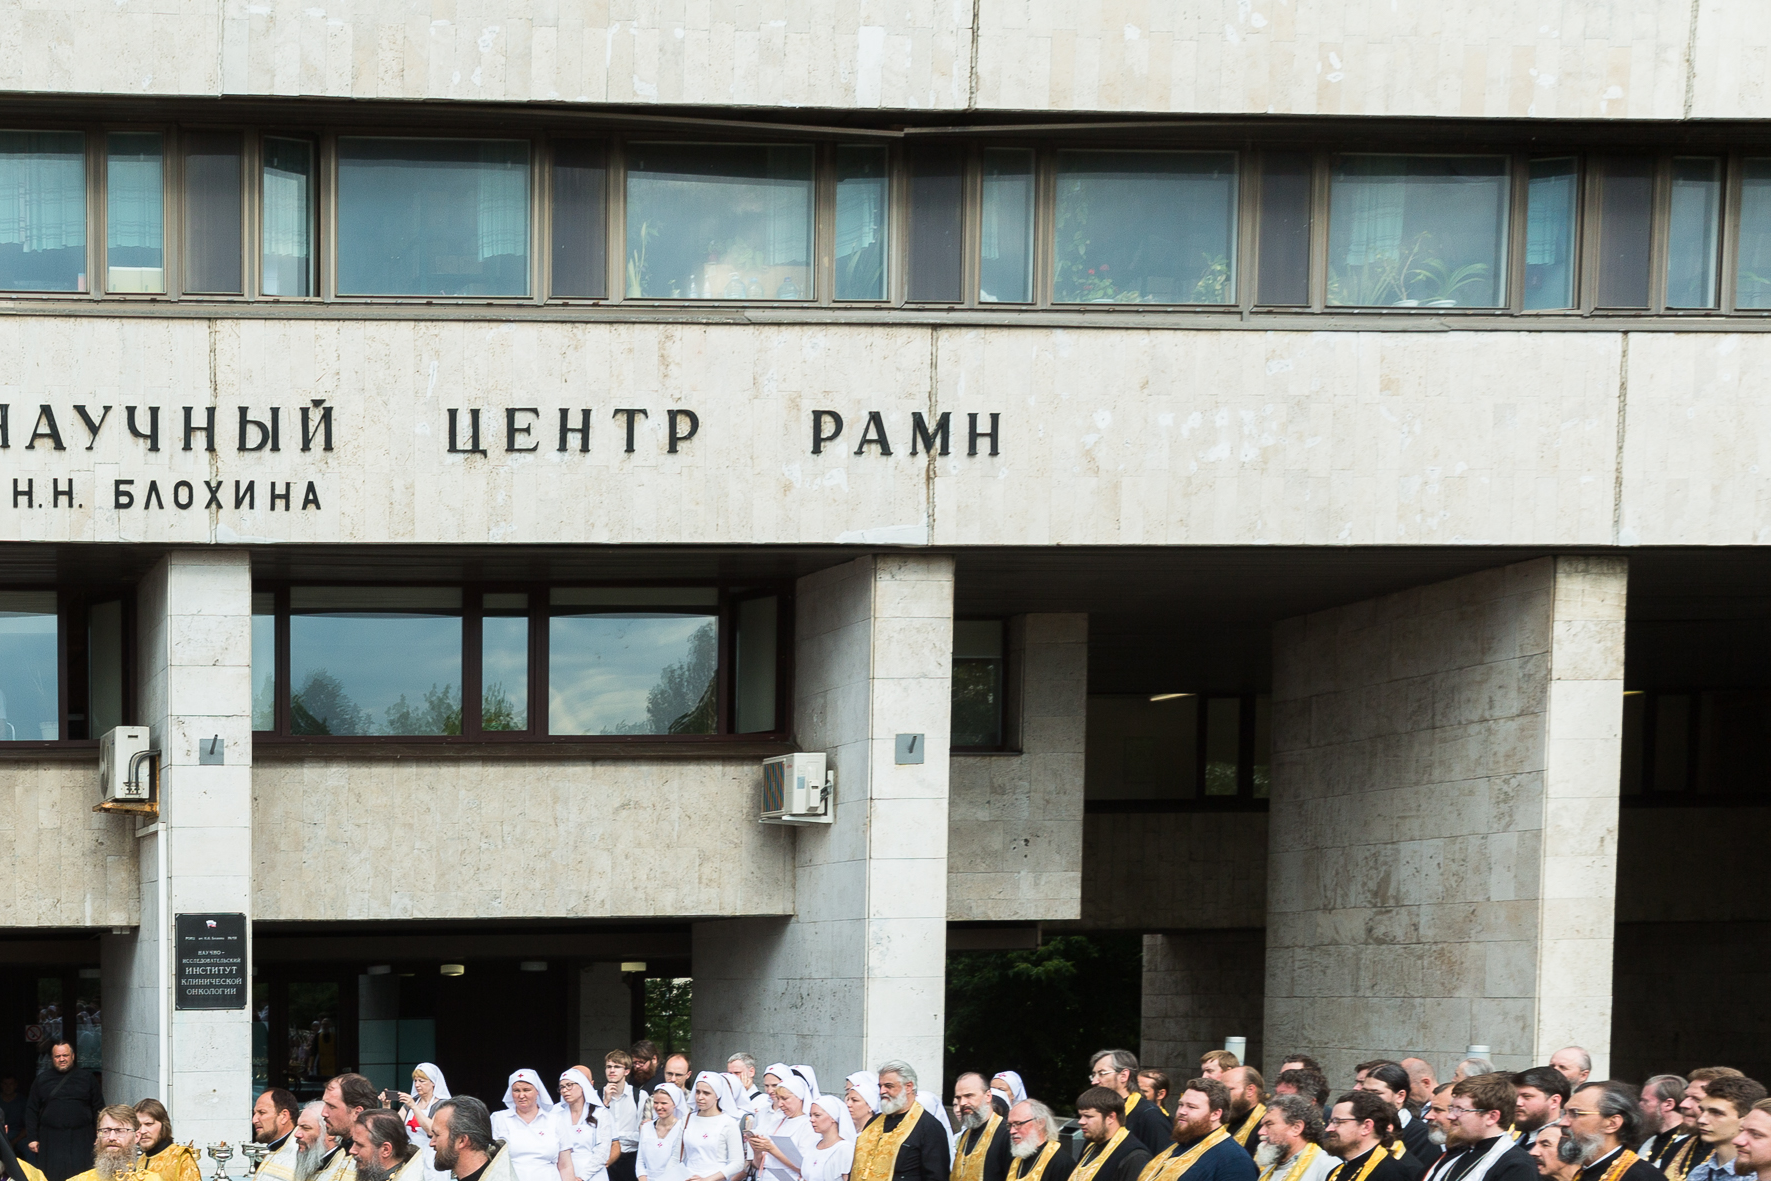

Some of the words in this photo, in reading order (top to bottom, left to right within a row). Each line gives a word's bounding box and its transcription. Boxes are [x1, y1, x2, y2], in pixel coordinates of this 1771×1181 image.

[447, 406, 701, 459] ЦЕНТР
[810, 409, 1002, 457] РАМН
[113, 479, 323, 512] БЛОХИНА
[185, 967, 238, 975] ИНСТИТУТ
[181, 977, 242, 986] КЛИНИЧЕСКОЙ
[186, 988, 237, 996] ОНКОЛОГИИ
